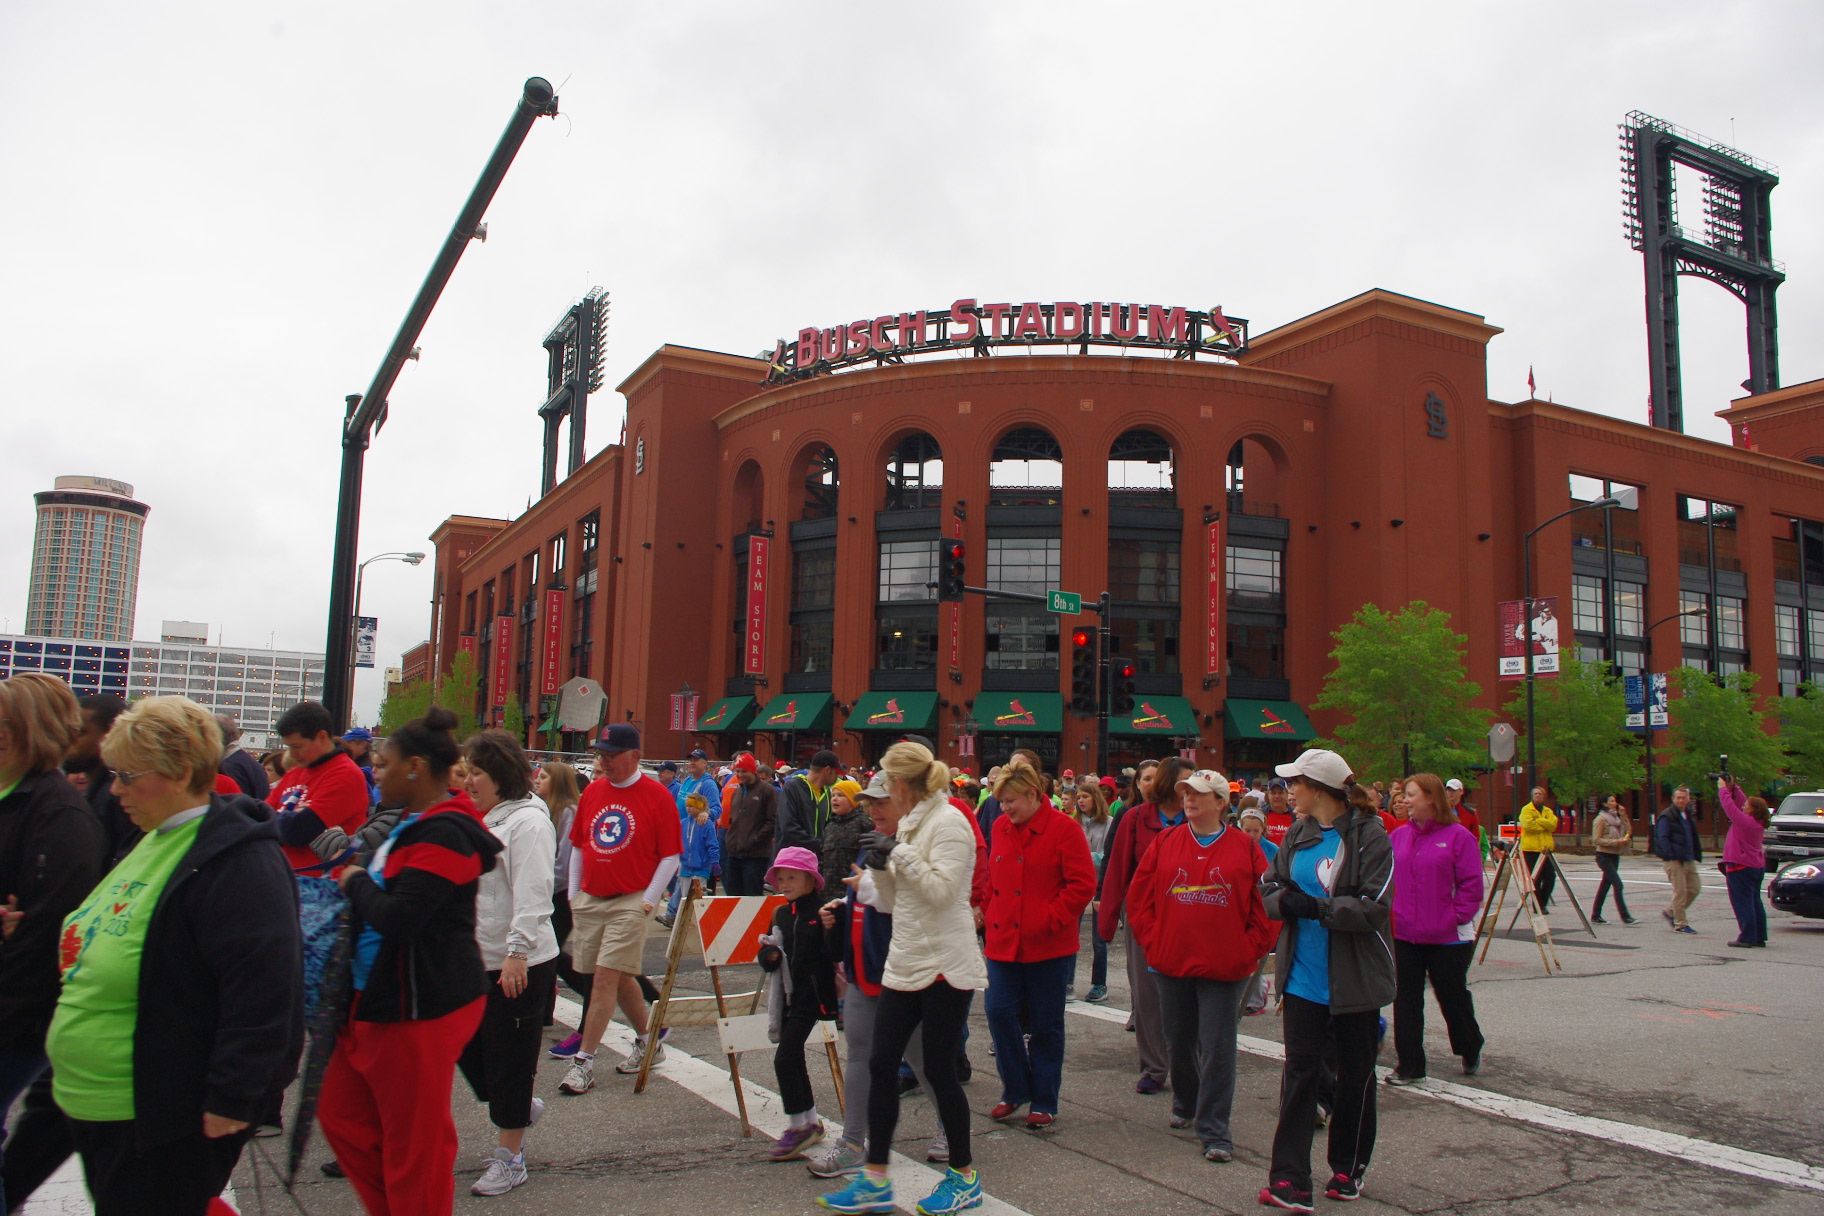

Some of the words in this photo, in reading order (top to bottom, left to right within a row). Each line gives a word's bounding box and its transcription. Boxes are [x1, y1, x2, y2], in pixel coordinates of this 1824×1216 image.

[796, 310, 928, 369] BUSCH
[950, 298, 1187, 343] STADIUM
[753, 542, 763, 591] TEAM
[1054, 594, 1067, 610] 8th
[752, 606, 760, 667] STORE
[498, 660, 506, 702] FIELD
[547, 641, 556, 690] FIELD
[592, 806, 608, 823] HEART
[610, 804, 627, 812] WALK
[626, 811, 635, 825] 2013
[1175, 890, 1228, 907] Cardinals
